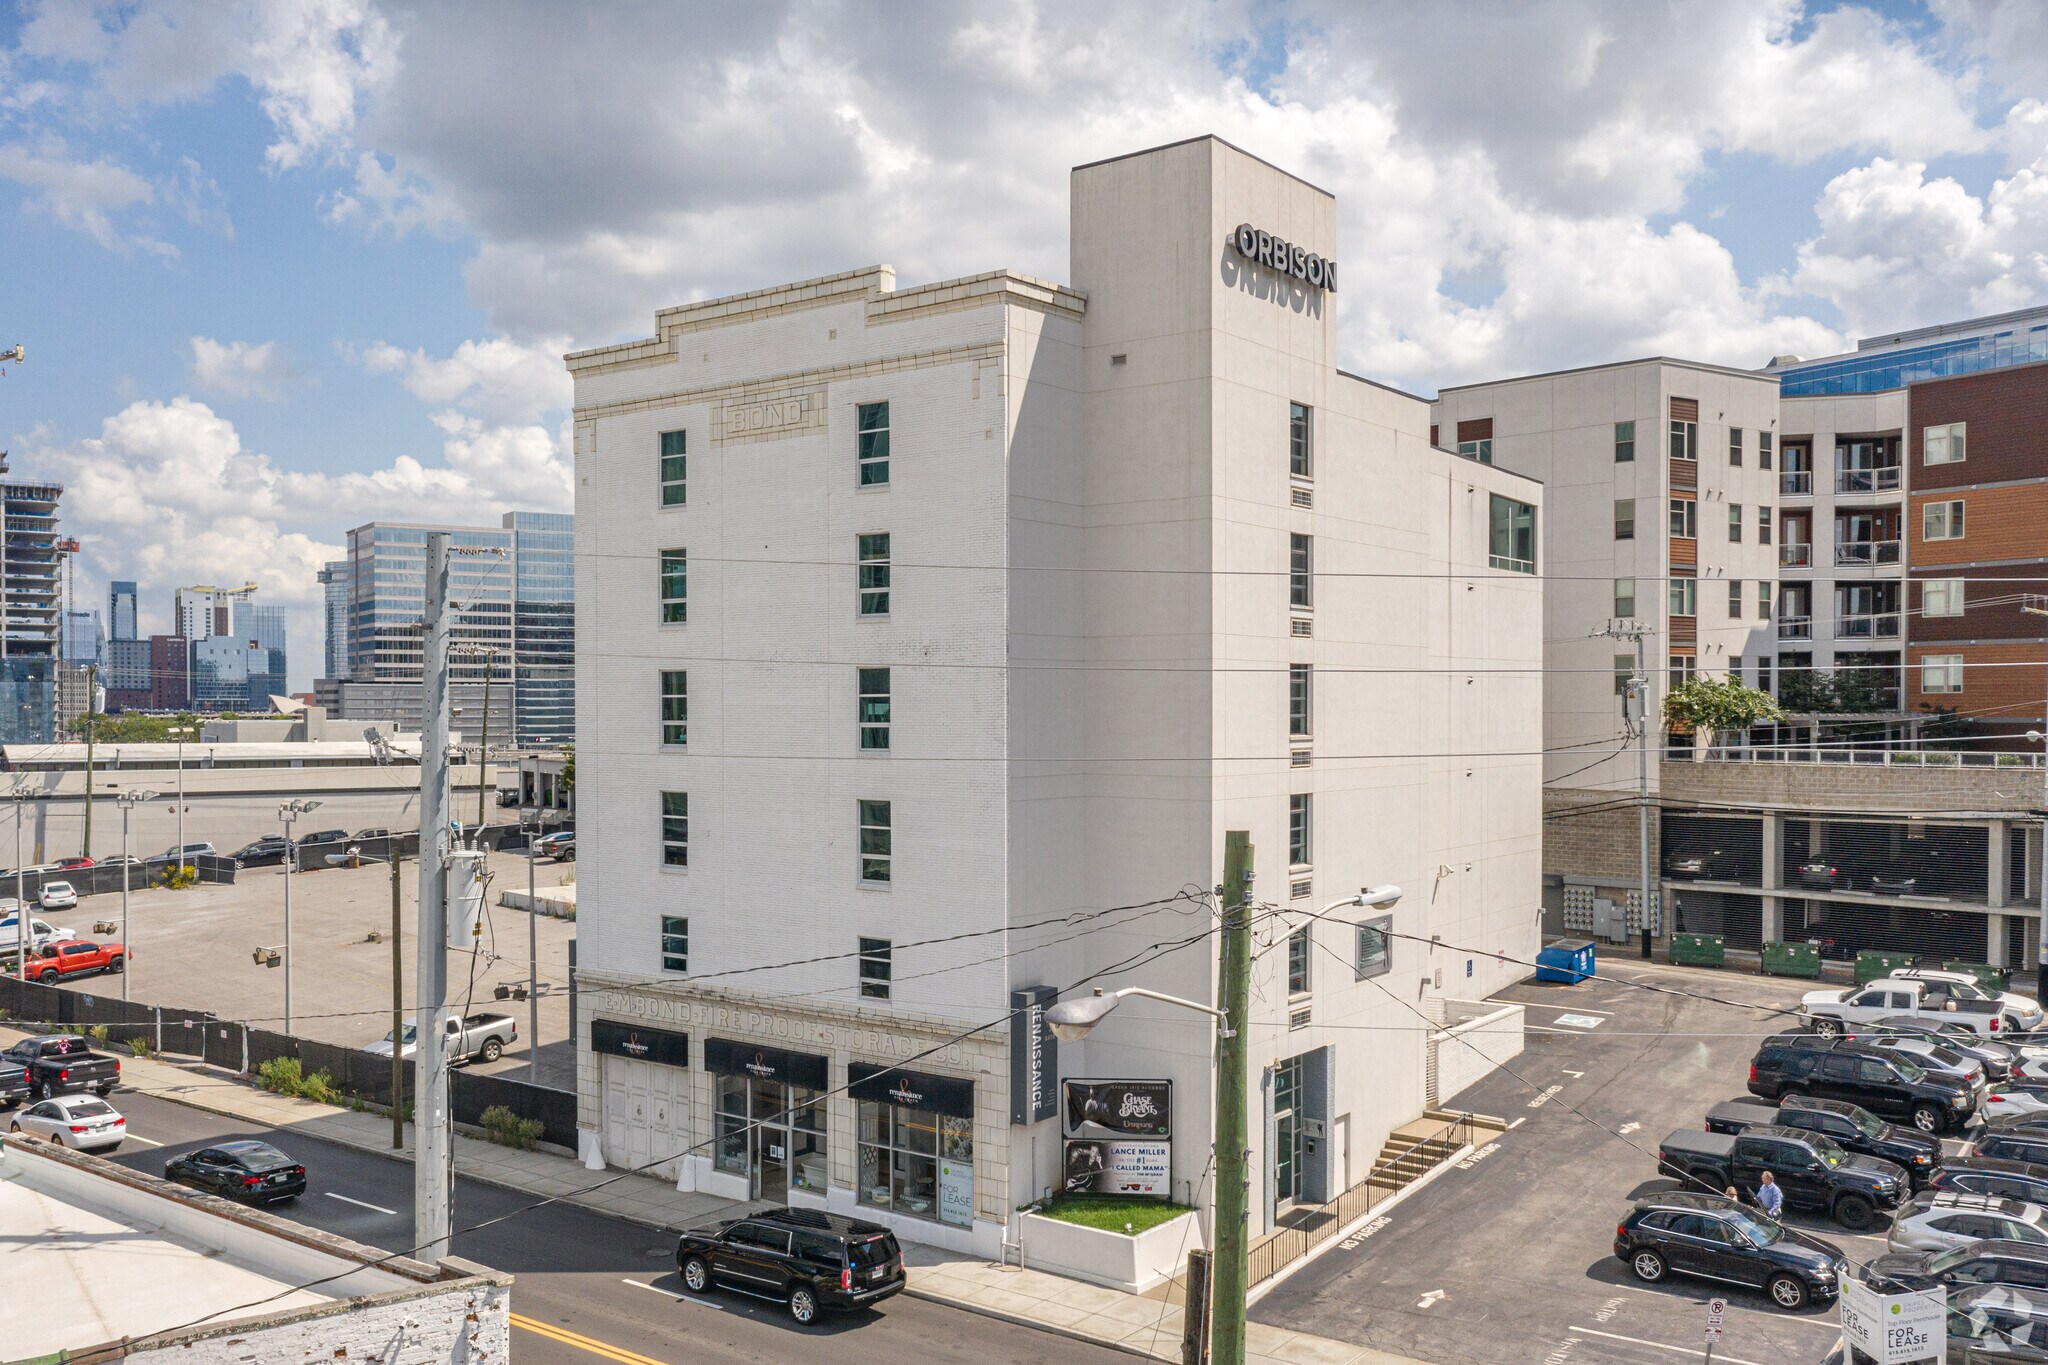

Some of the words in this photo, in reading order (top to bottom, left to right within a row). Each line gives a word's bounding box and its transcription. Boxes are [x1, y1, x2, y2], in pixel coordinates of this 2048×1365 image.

[1235, 223, 1337, 293] ORBISON
[730, 400, 802, 433] BOND
[747, 1012, 818, 1041] PROOF
[1032, 1003, 1042, 1111] RENAISSANCE
[1455, 1160, 1474, 1170] NO
[1466, 1142, 1502, 1162] PARKING
[943, 1184, 959, 1194] FOR
[943, 1193, 972, 1208] LEASE
[1338, 1239, 1360, 1250] NO
[1351, 1216, 1392, 1241] PARKING
[1842, 1305, 1859, 1324] FOR
[1842, 1316, 1869, 1340] LEASE
[1888, 1326, 1914, 1339] FOR
[1888, 1333, 1928, 1348] LEASE
